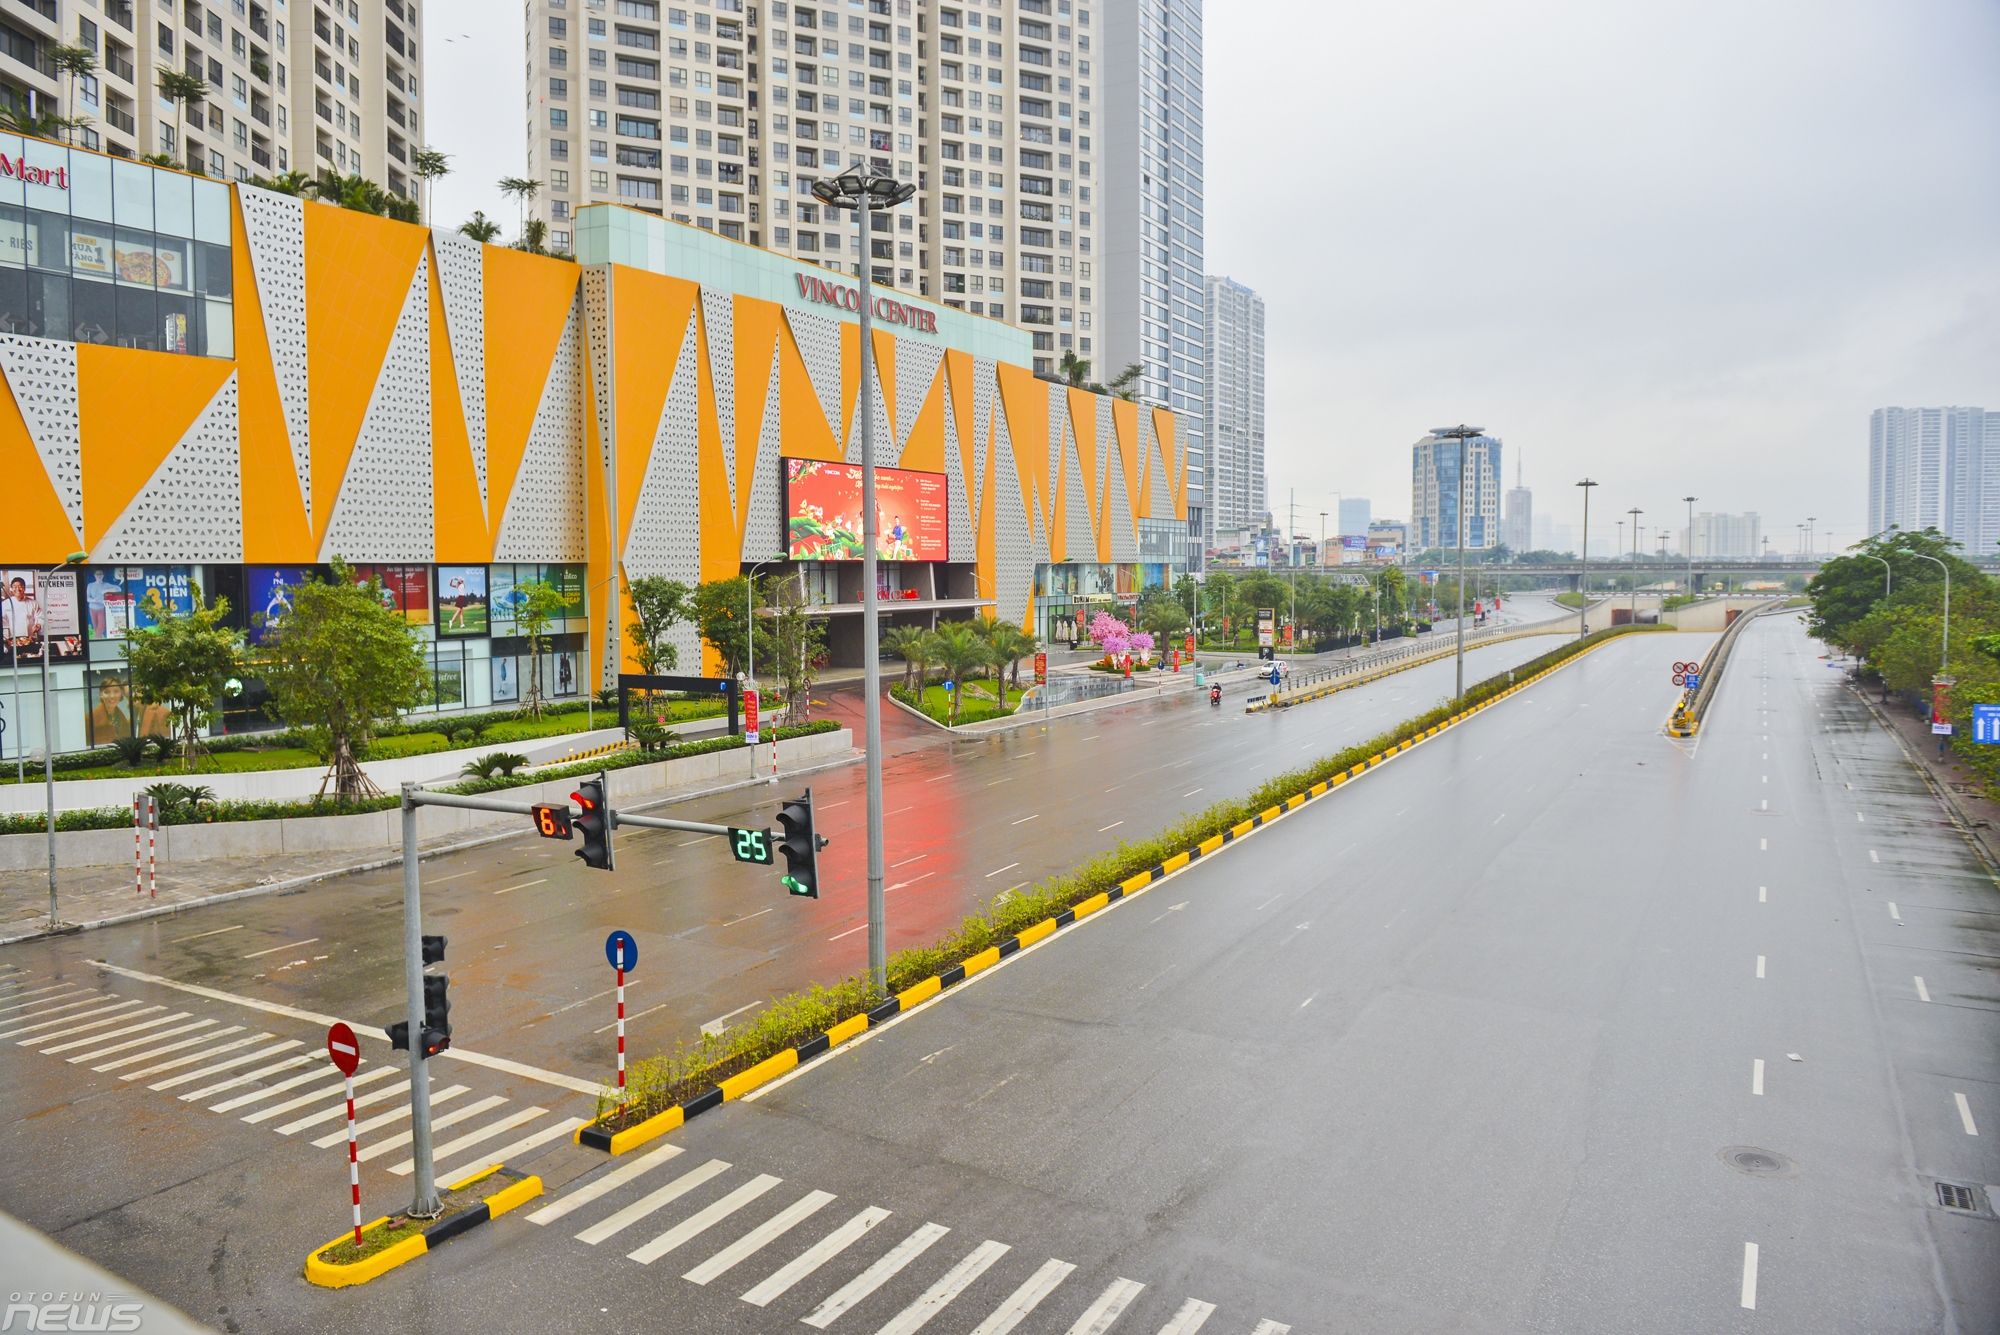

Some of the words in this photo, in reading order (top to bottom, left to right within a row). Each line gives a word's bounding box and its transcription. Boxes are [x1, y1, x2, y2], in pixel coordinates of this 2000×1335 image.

[0, 153, 69, 189] Mart
[10, 236, 33, 250] RIBS
[876, 297, 939, 334] CENTER
[146, 572, 188, 587] HOÀN
[163, 584, 188, 598] TIỀN
[737, 829, 767, 861] 25
